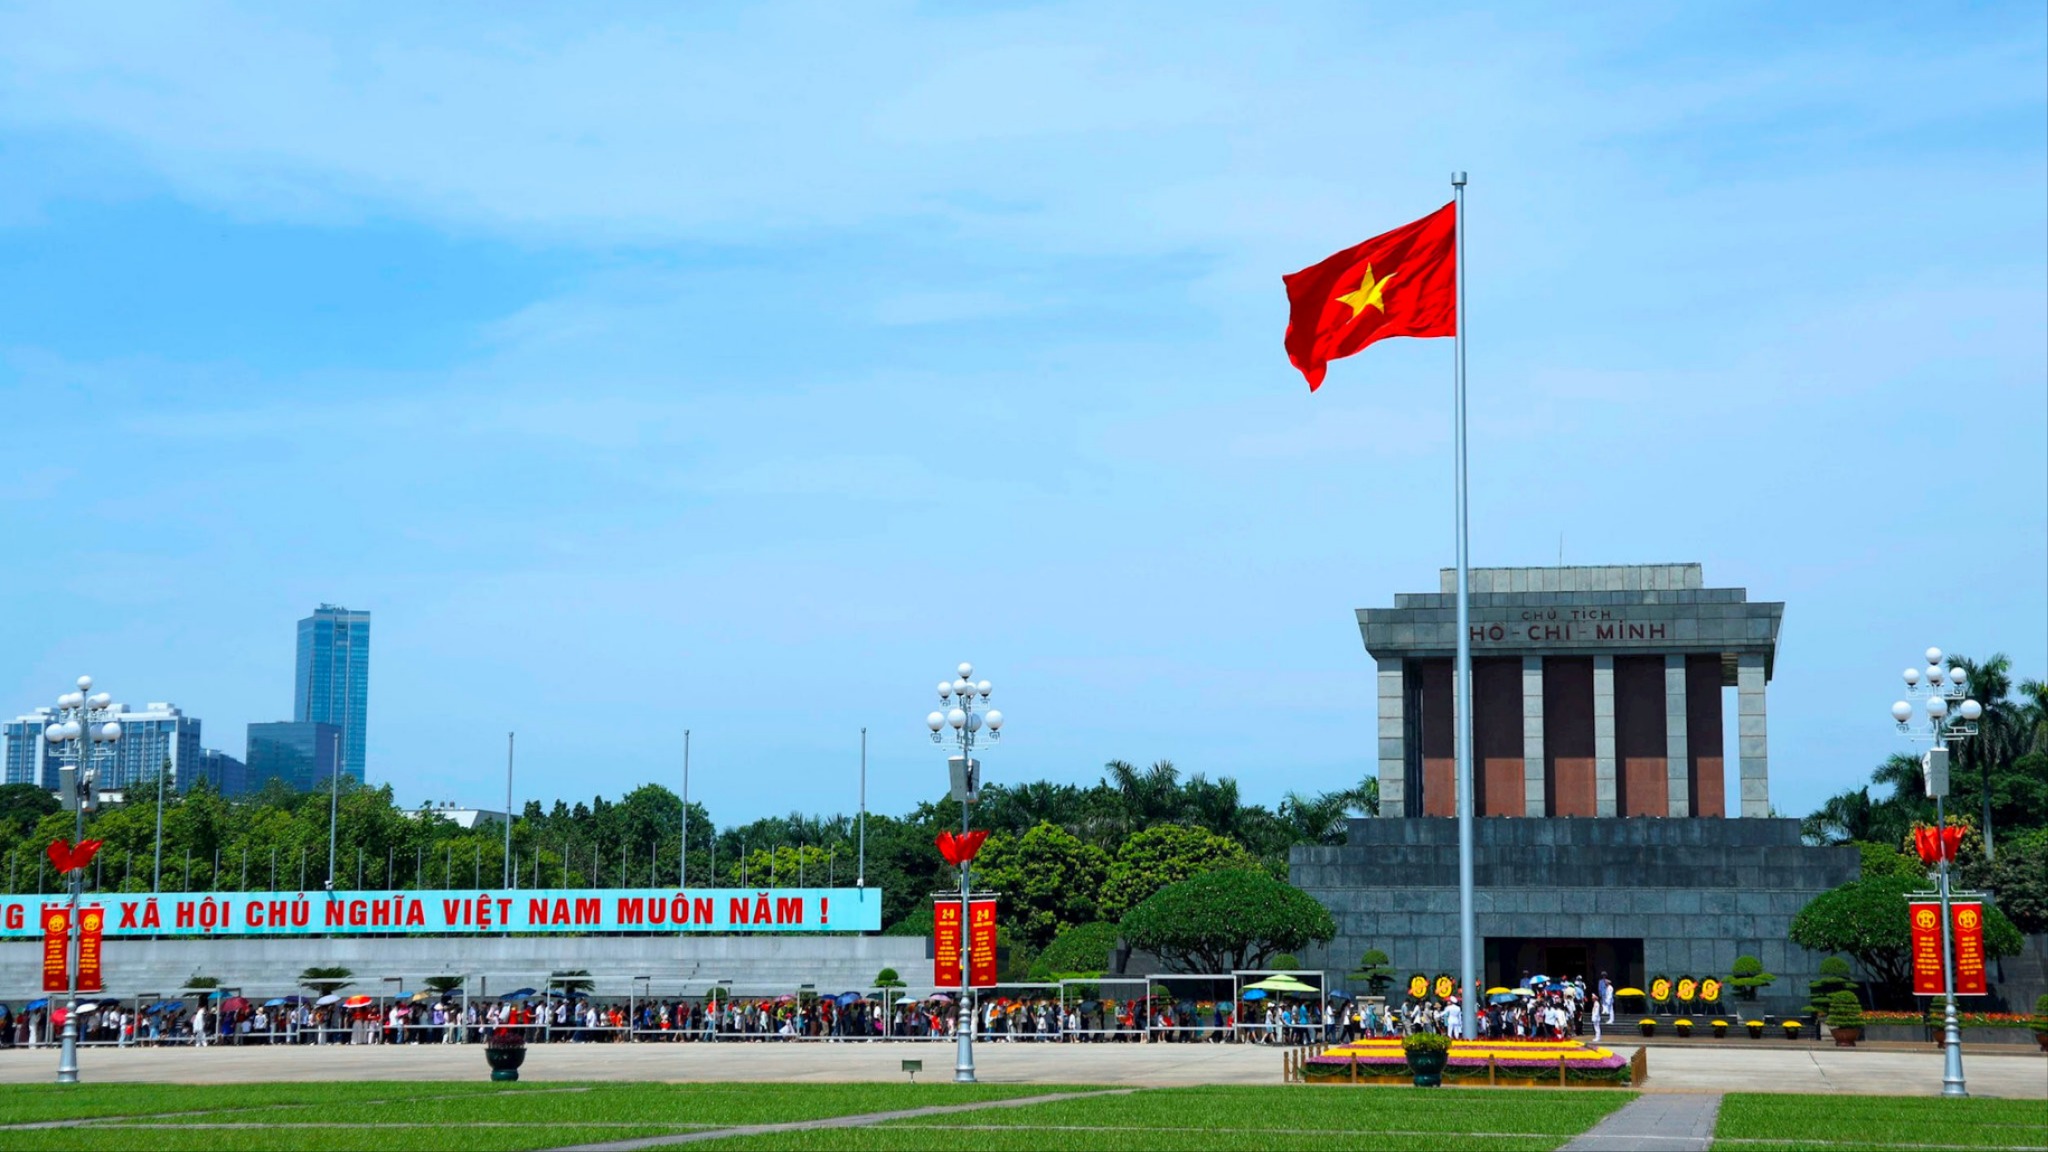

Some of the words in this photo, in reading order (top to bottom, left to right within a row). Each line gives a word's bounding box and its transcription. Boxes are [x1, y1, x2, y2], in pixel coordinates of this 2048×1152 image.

[0, 903, 24, 930] G
[119, 898, 160, 929] XÃ
[176, 896, 230, 932] HỘI
[245, 893, 309, 927] CHỦ
[325, 895, 425, 926] NGHĨA
[443, 894, 513, 929] VIỆT
[528, 898, 601, 925] NAM
[617, 893, 713, 924] MUÔN
[729, 893, 803, 924] NĂM
[820, 897, 828, 923] !
